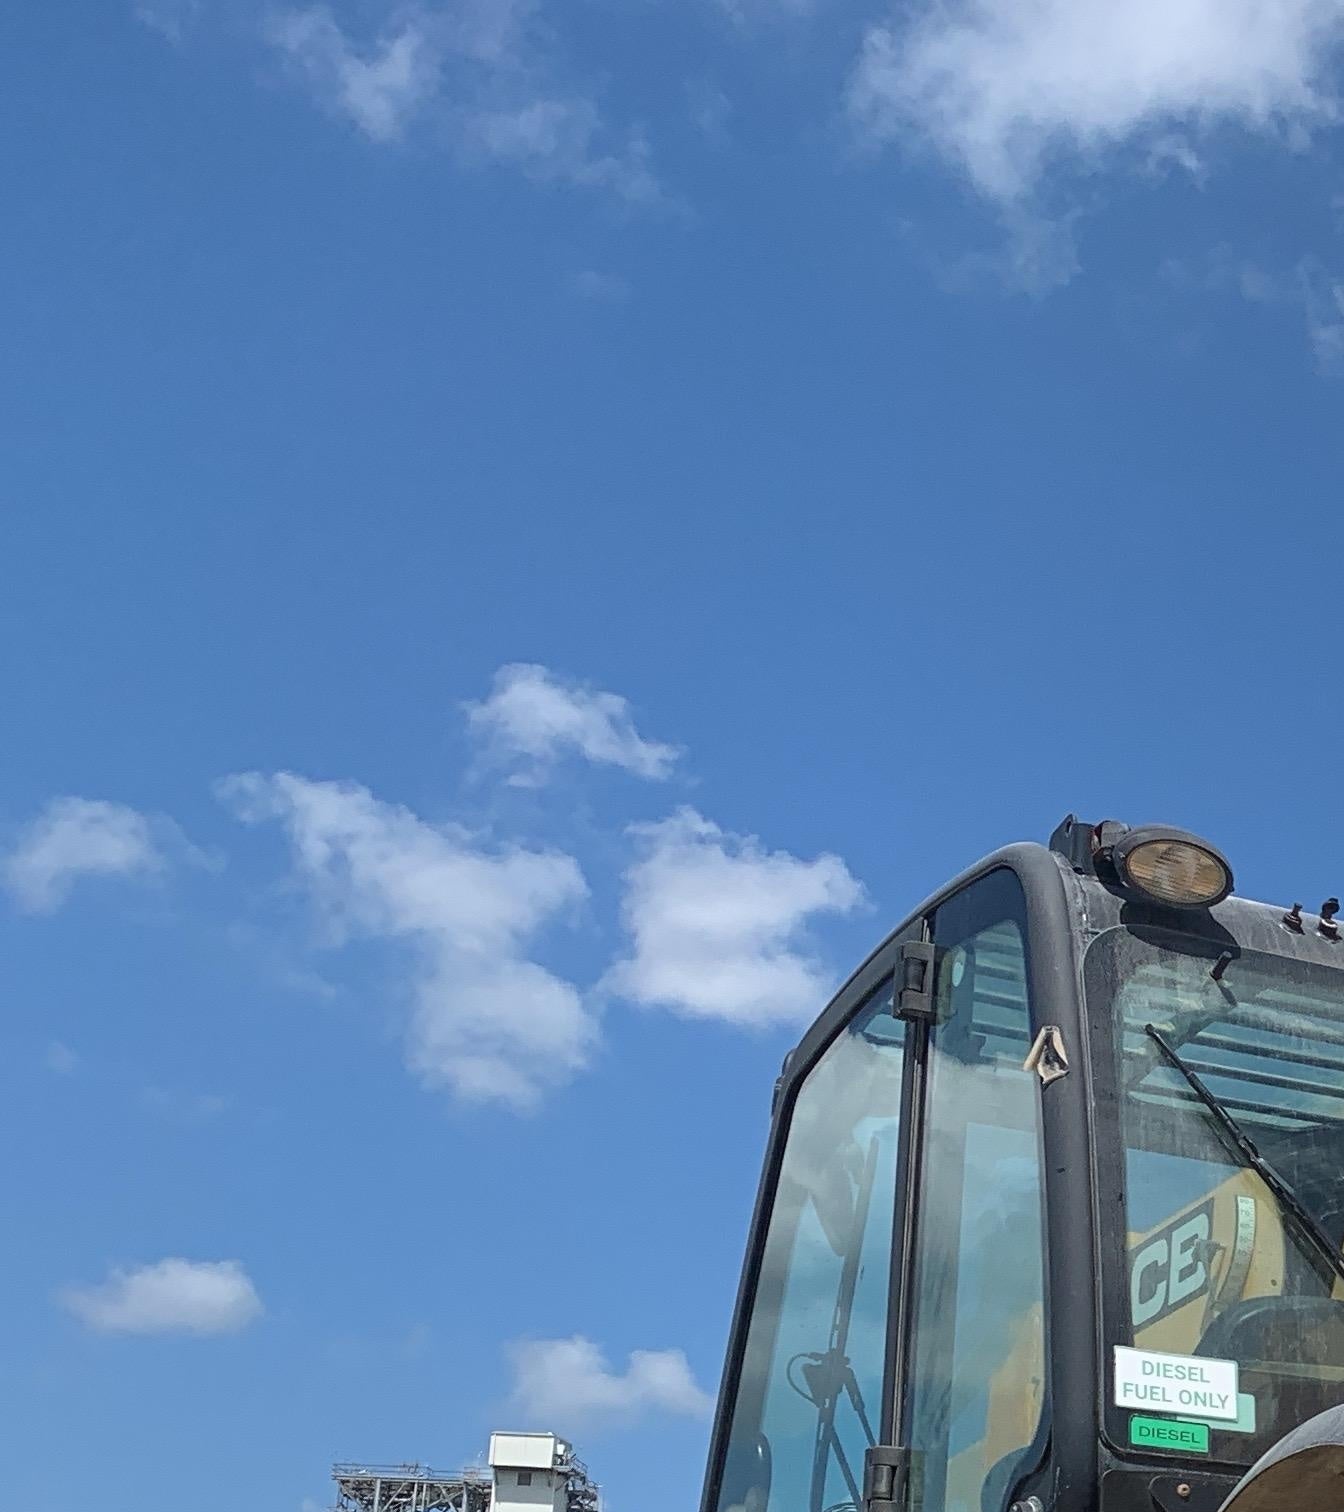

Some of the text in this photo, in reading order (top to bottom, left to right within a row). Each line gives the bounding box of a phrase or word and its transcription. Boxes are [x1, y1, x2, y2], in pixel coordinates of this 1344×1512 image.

[1141, 1359, 1210, 1384] DIESEL
[1123, 1382, 1229, 1410] FUEL ONLY
[1138, 1425, 1200, 1444] DIESEL
